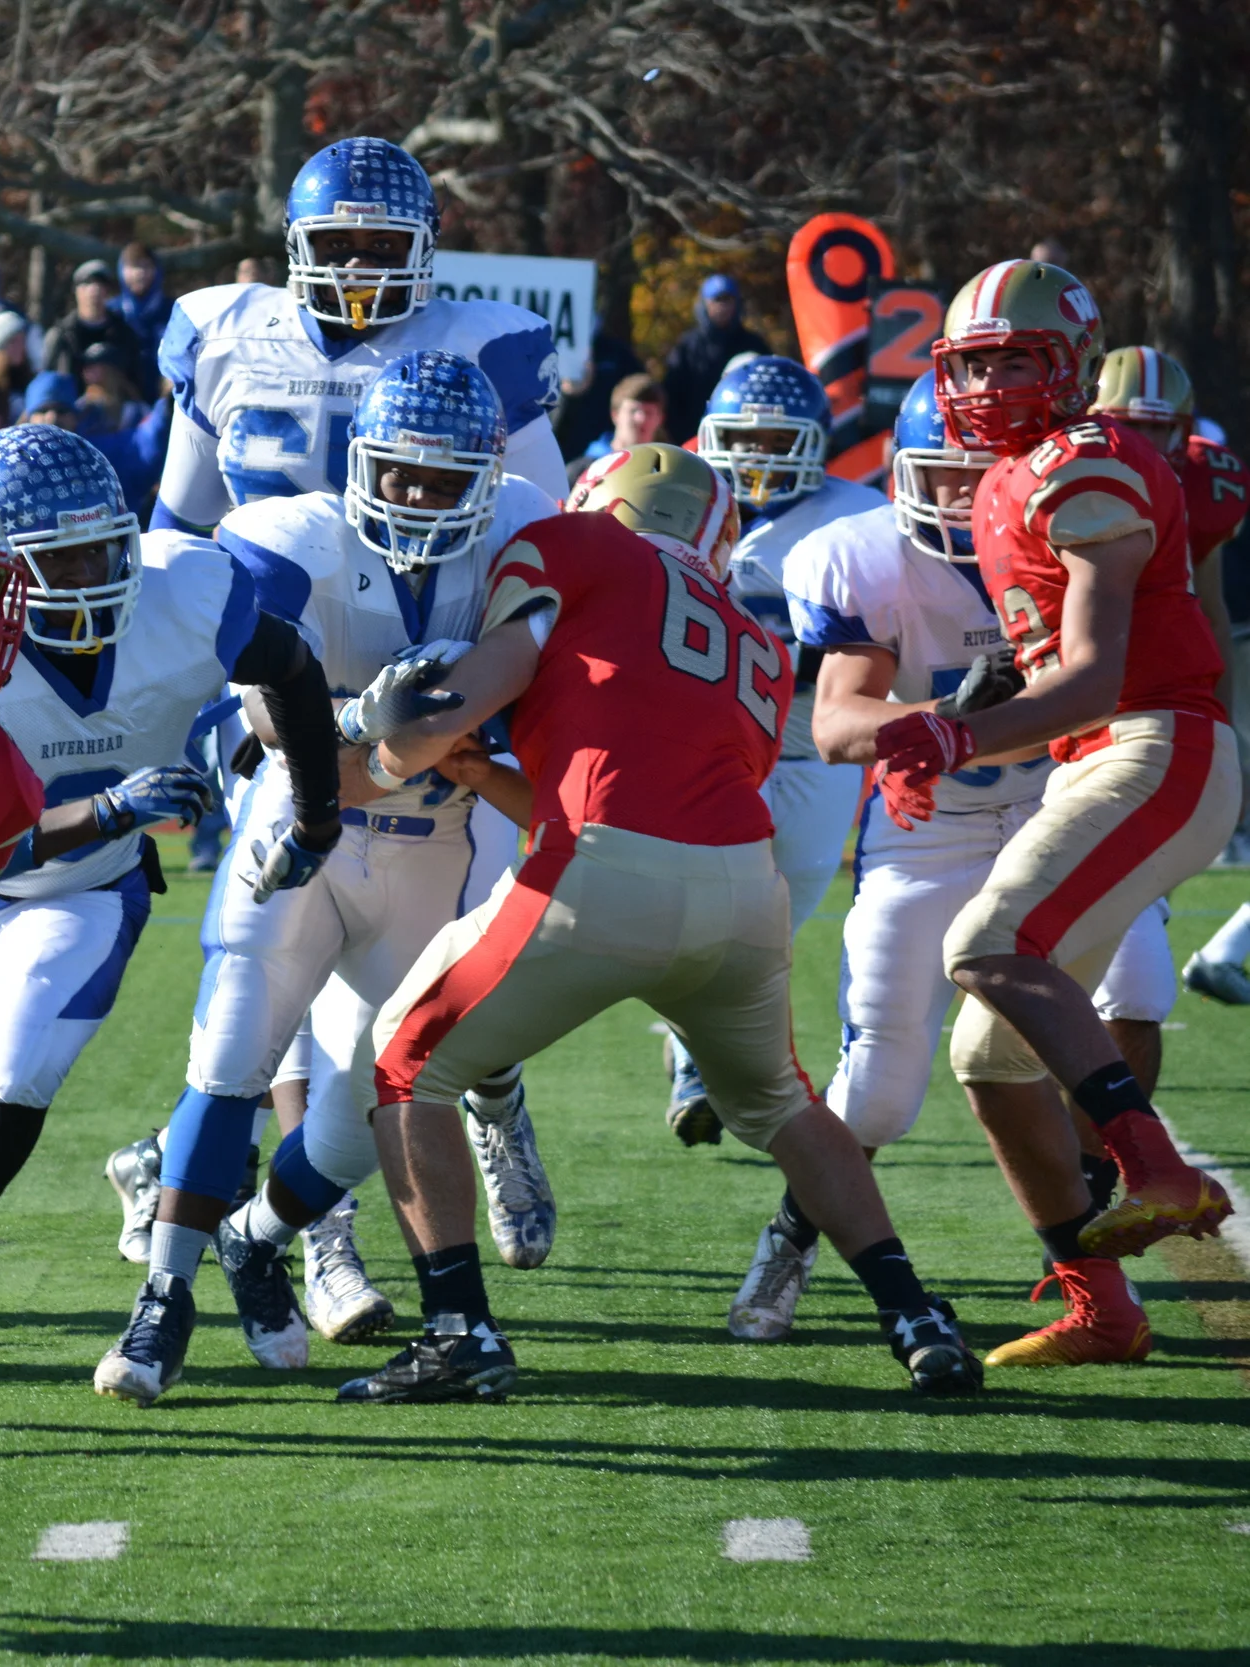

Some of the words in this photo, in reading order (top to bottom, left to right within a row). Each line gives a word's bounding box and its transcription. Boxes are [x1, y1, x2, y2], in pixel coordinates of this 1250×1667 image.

[869, 289, 943, 379] 2
[287, 379, 364, 397] RIVERHEAD
[70, 507, 101, 525] Riddell
[657, 549, 783, 743] 62
[963, 628, 1003, 647] RIVER
[40, 734, 124, 760] RIVERHEAD
